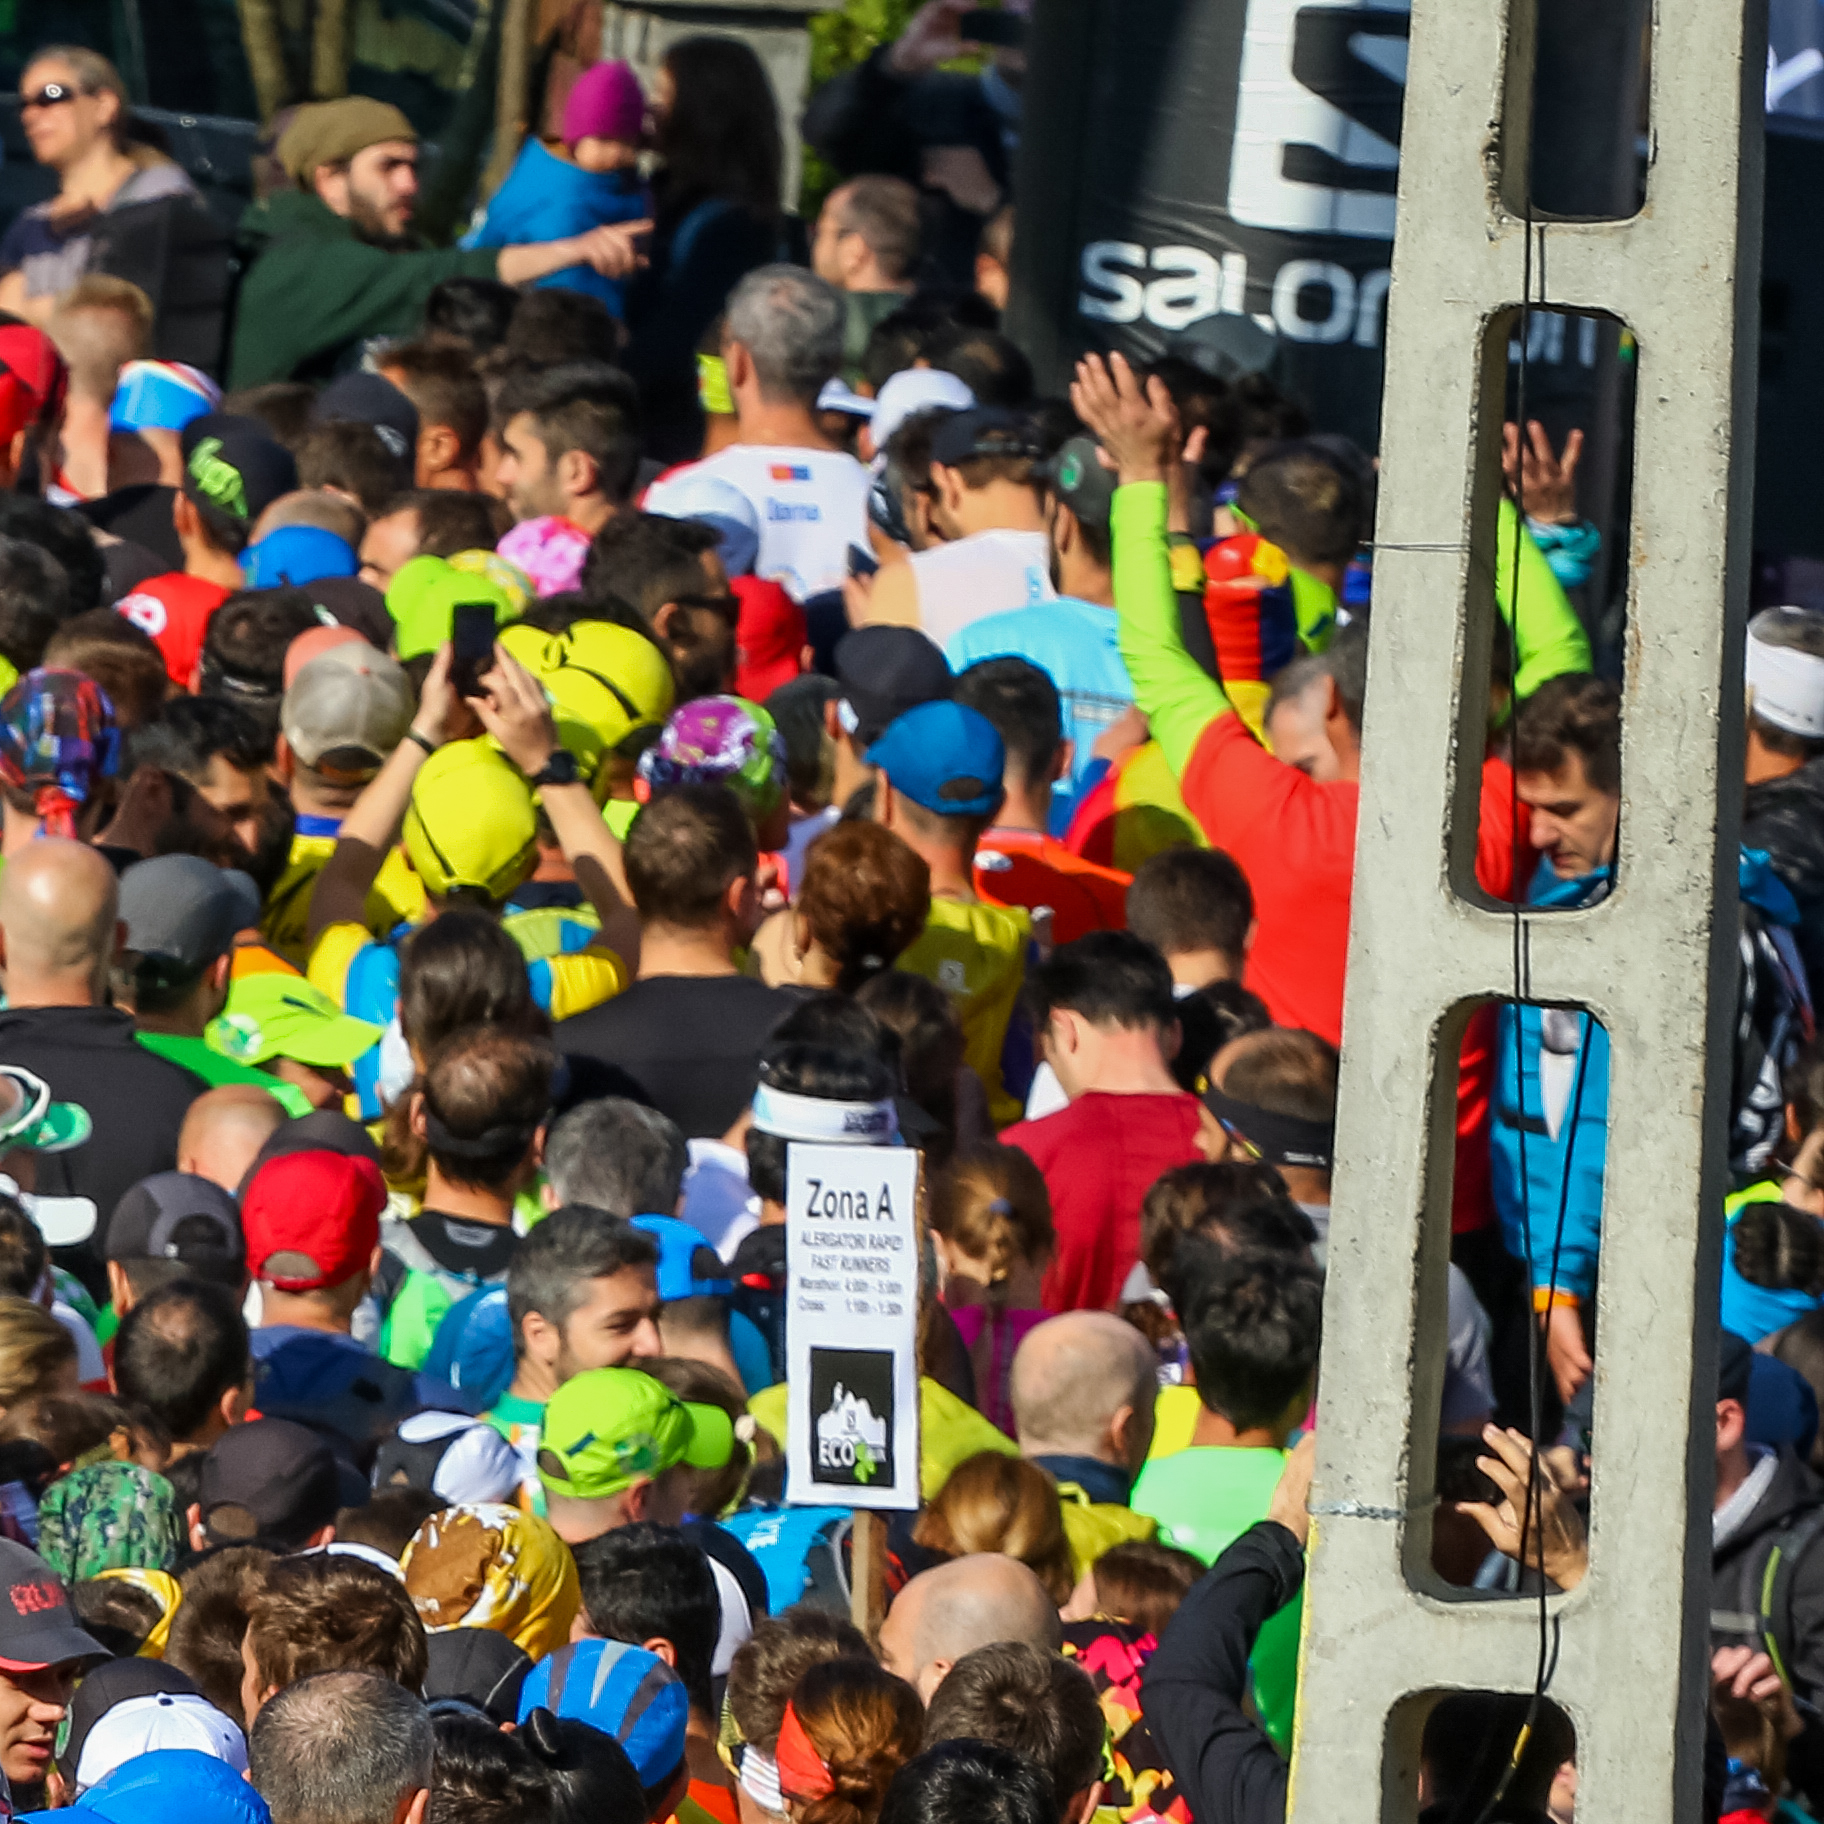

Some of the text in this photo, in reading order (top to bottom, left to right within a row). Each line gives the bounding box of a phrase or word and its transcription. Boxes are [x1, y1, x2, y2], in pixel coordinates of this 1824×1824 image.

[806, 1178, 895, 1221] Zona A
[819, 1437, 855, 1468] ECO
